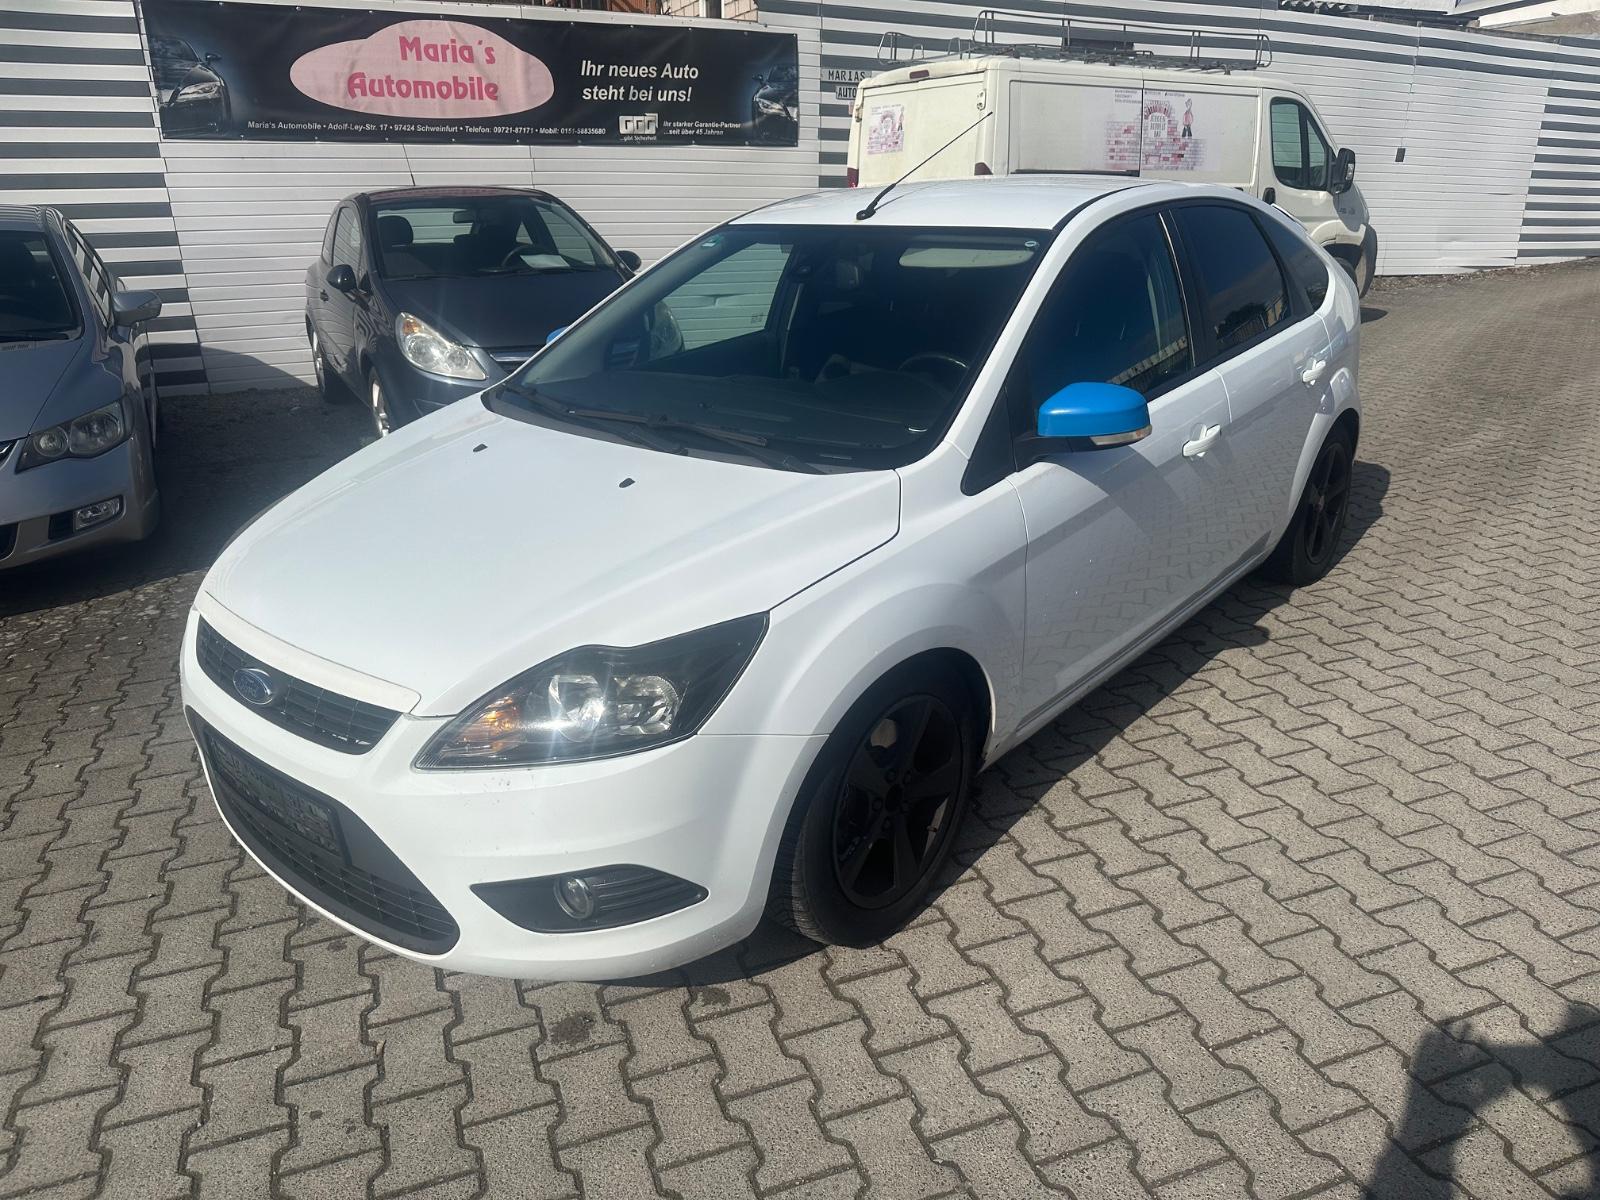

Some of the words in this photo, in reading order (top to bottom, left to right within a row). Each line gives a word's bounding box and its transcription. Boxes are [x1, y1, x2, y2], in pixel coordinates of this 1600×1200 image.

[581, 60, 605, 76] Ihr
[608, 64, 657, 78] neues
[660, 63, 699, 79] Auto
[828, 70, 866, 81] MARIAS
[347, 72, 499, 101] Automobile
[582, 85, 625, 101] steht
[628, 85, 653, 101] bei
[657, 86, 692, 102] uns!
[277, 121, 322, 130] Automobile
[327, 122, 377, 132] Adolf-Ley-Str.
[394, 124, 415, 132] 97424
[416, 124, 459, 133] Schweinfurt
[464, 125, 492, 133] Telefon:
[493, 126, 534, 134] 09721-87171
[694, 121, 741, 129] Garantie-Partner
[681, 128, 695, 136] über
